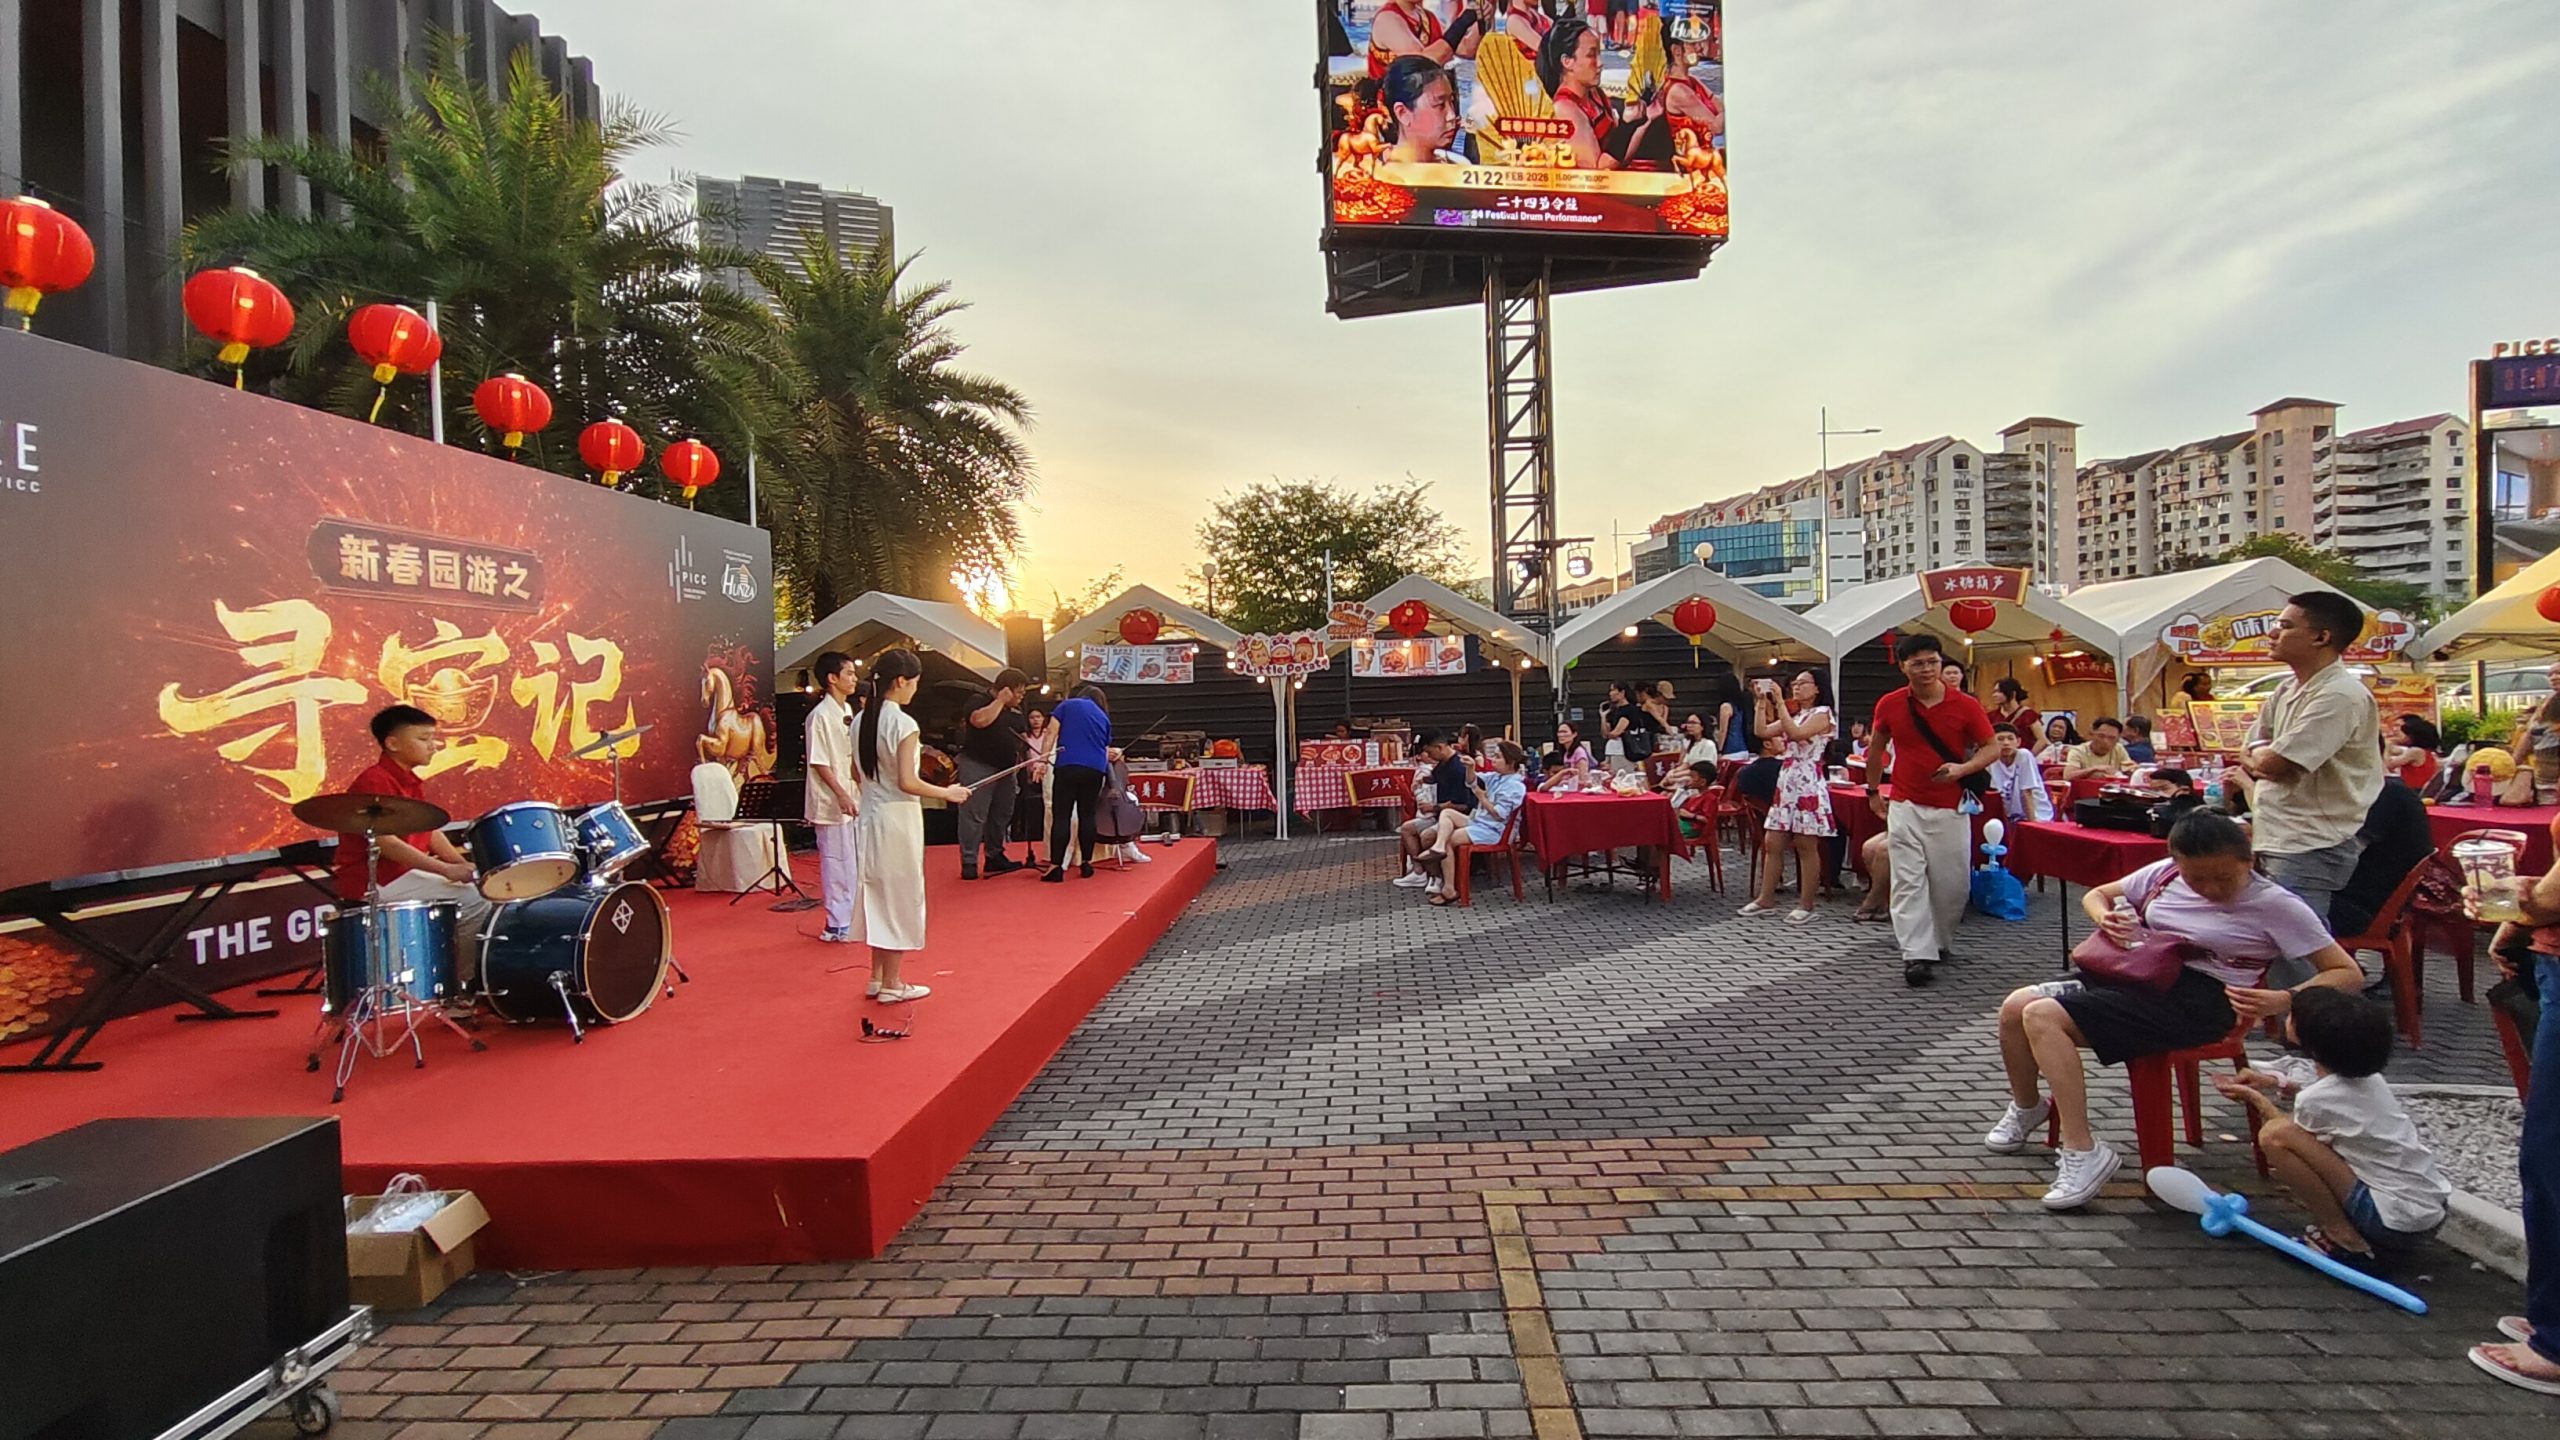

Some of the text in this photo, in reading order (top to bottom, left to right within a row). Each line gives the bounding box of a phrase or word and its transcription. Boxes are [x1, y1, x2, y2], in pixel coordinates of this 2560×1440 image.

[1505, 172, 1523, 181] FEB
[1526, 172, 1549, 182] 2026
[1485, 210, 1518, 221] Festival
[1520, 212, 1543, 221] Drum
[2491, 338, 2560, 359] PICC
[0, 477, 40, 493] ICC
[338, 533, 532, 600] 新春园游之
[682, 571, 707, 585] PICC
[722, 563, 755, 598] HUNZA
[1943, 574, 2005, 592] 冰糖葫芦
[159, 598, 641, 804] 寻宝记
[186, 916, 273, 965] THE
